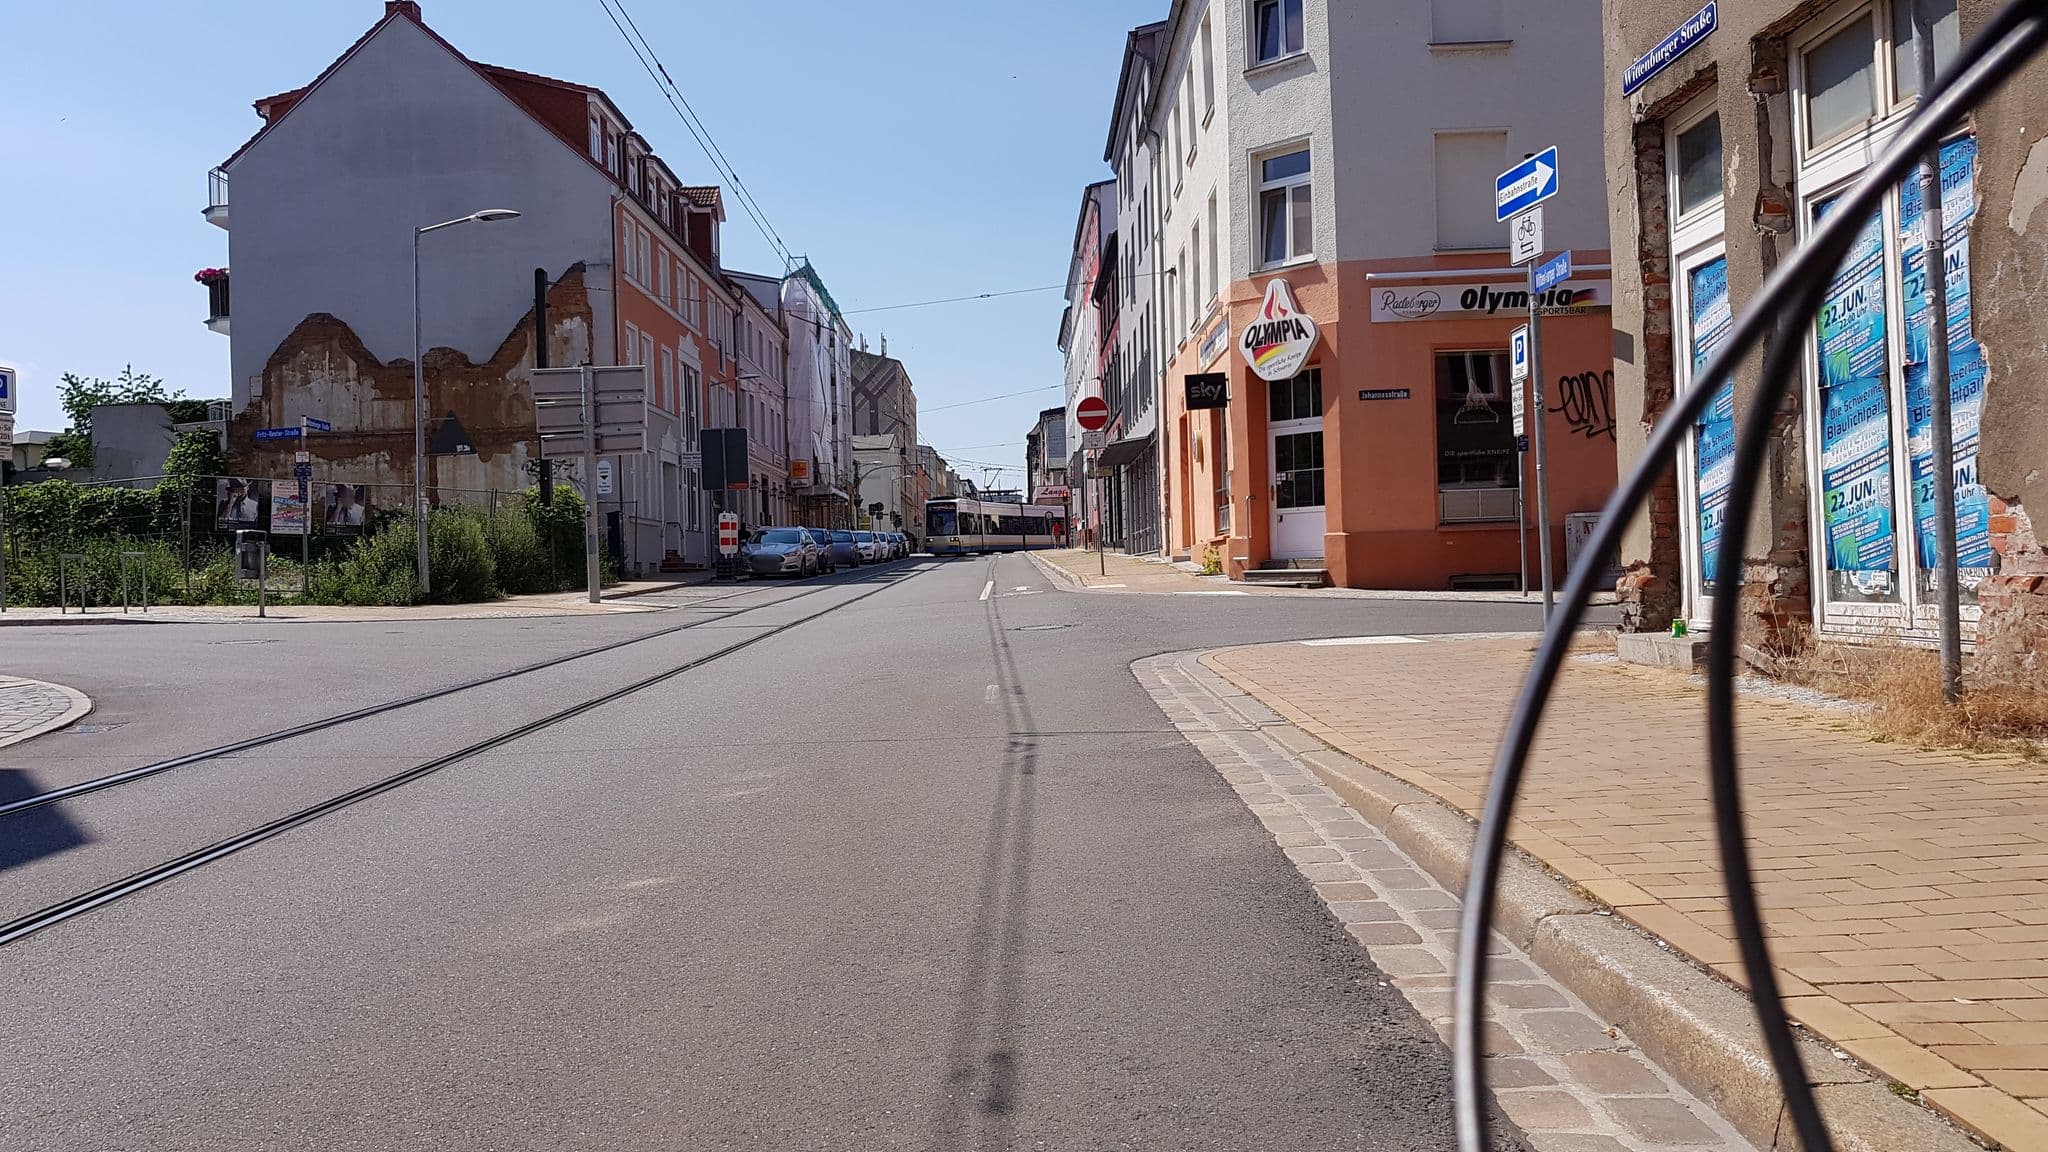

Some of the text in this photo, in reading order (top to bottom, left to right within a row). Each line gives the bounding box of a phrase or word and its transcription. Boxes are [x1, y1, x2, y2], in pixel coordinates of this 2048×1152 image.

[1624, 10, 1712, 86] Wittenburger Straße
[1498, 176, 1538, 203] Einbahnstraße
[1909, 181, 1921, 197] Di
[1950, 271, 1965, 287] Uhr
[1381, 290, 1438, 312] Radeberger
[1824, 286, 1867, 329] 22.JUN.
[1244, 317, 1310, 349] OLYMPIA
[1516, 341, 1523, 361] P
[1191, 381, 1222, 401] sky
[1830, 383, 1888, 421] Die Schwerine
[1831, 478, 1876, 513] 22.JUN.
[1961, 486, 1975, 499] Uhr
[1847, 497, 1877, 518] 22:00 Uhr
